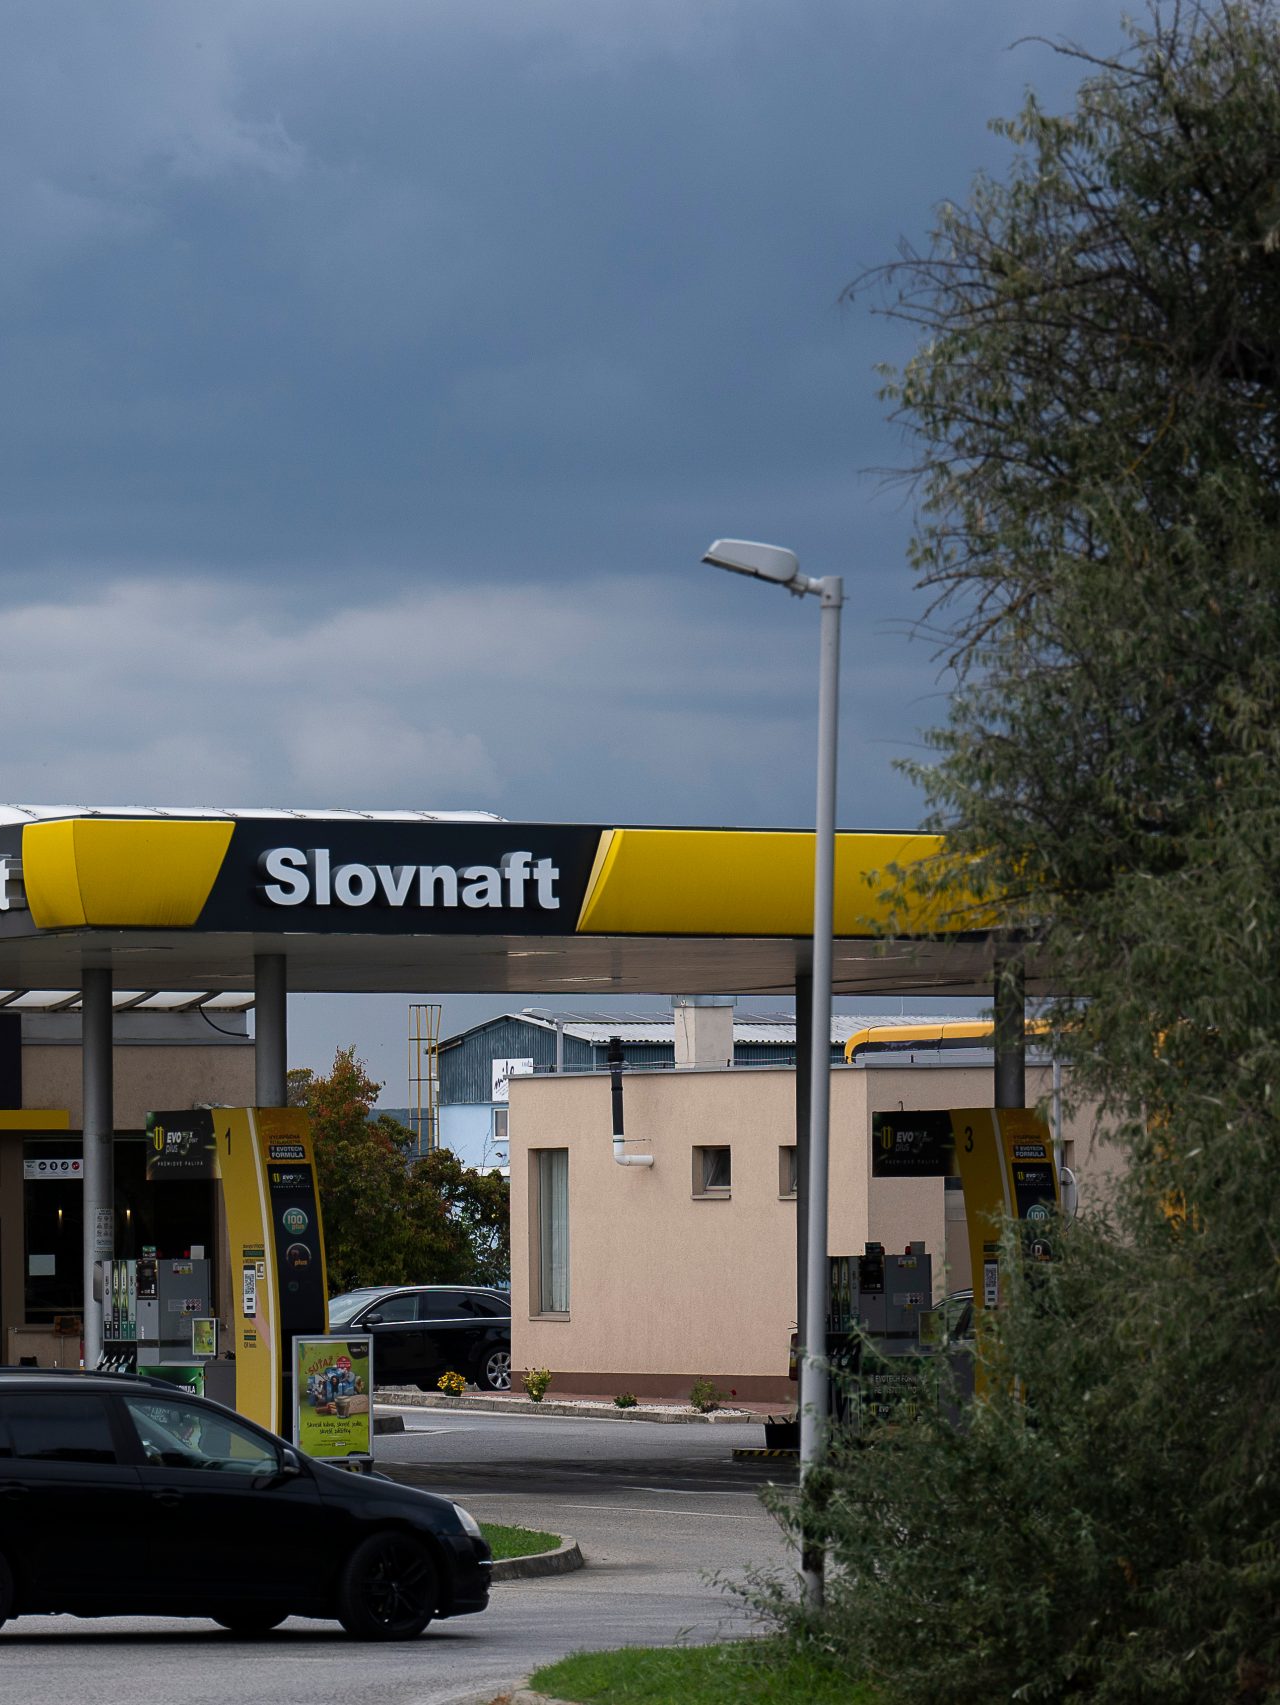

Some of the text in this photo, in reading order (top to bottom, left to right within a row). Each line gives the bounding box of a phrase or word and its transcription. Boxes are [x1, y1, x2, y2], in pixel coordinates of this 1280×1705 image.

[262, 847, 560, 910] Slovnaft
[166, 1131, 182, 1143] EVO
[225, 1127, 231, 1155] 1
[896, 1131, 914, 1143] EVO
[964, 1126, 974, 1153] 3
[287, 1214, 303, 1225] 100
